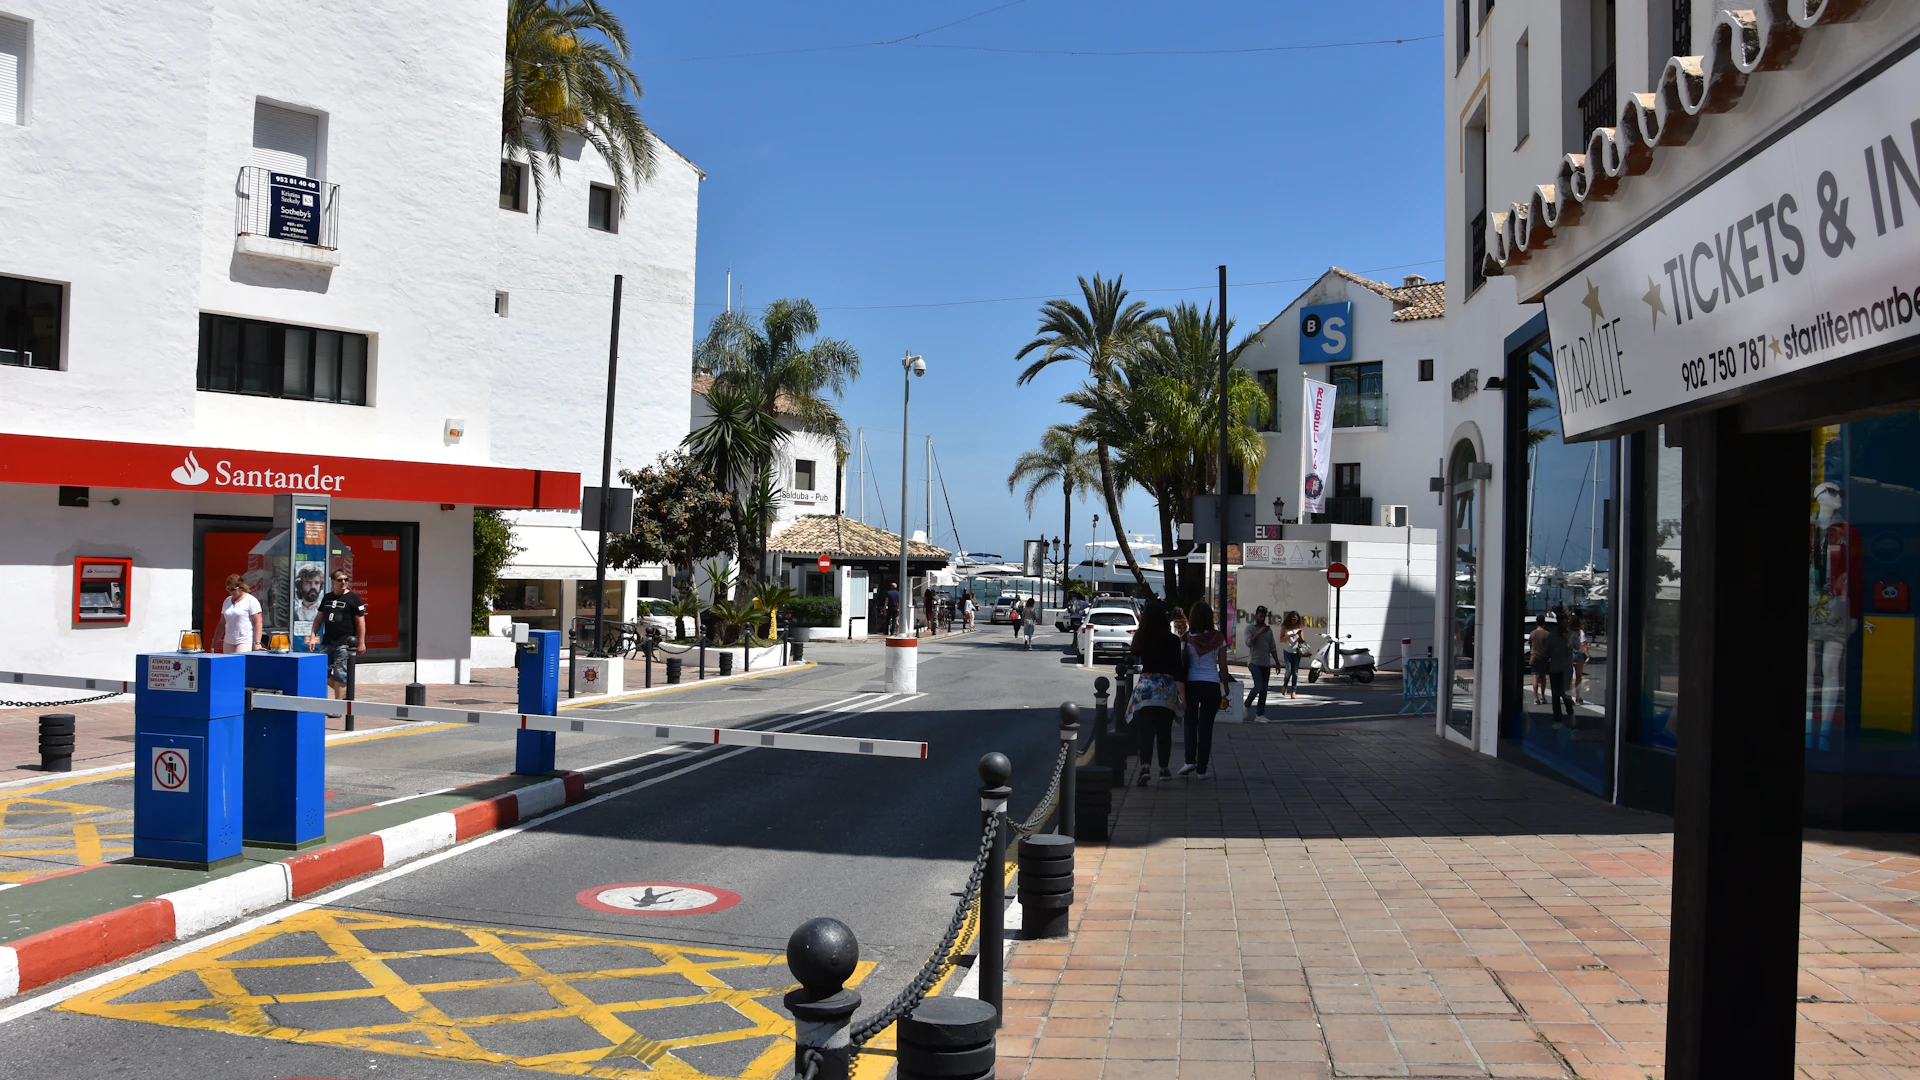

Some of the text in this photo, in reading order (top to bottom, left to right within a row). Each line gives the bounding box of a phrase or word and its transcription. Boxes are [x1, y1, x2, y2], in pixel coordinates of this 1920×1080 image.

[275, 175, 288, 184] 952
[280, 206, 311, 218] Sotheby's
[1663, 193, 1805, 326] TICKETS
[1816, 170, 1856, 258] &
[1307, 316, 1346, 354] B S
[1556, 317, 1632, 416] STARLITE
[1682, 357, 1707, 392] 902
[1709, 346, 1736, 382] 750
[1739, 334, 1766, 374] 787
[1313, 387, 1324, 443] REBEL
[215, 460, 345, 491] Santander
[782, 491, 808, 500] Salduba
[816, 493, 828, 501] Pub
